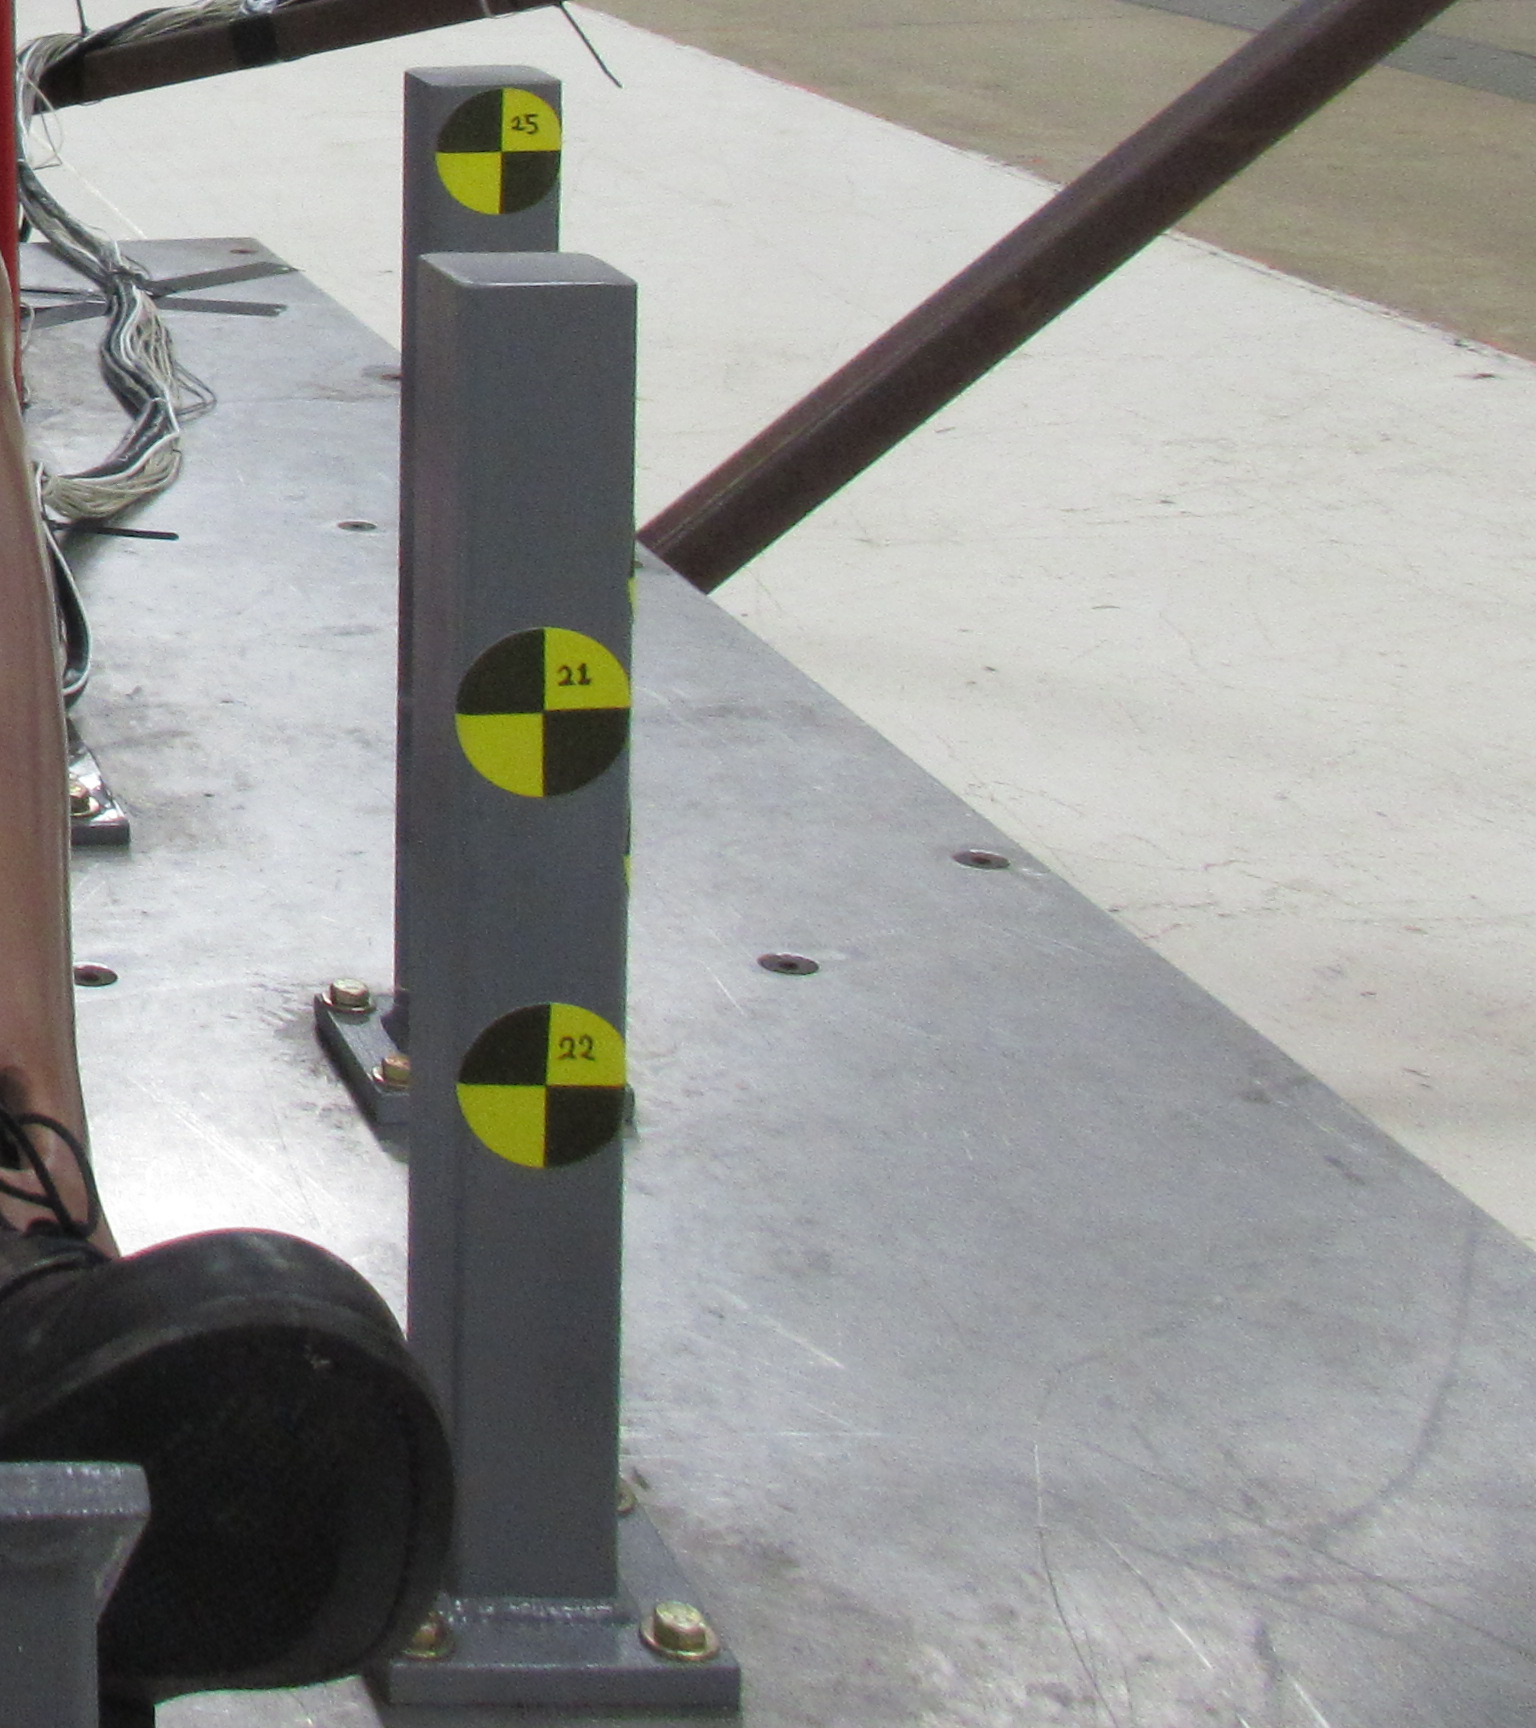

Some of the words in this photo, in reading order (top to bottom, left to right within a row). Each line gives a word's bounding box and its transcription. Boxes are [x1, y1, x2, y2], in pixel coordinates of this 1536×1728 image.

[511, 113, 539, 135] 25
[557, 663, 591, 687] 21
[557, 1034, 595, 1061] 22
